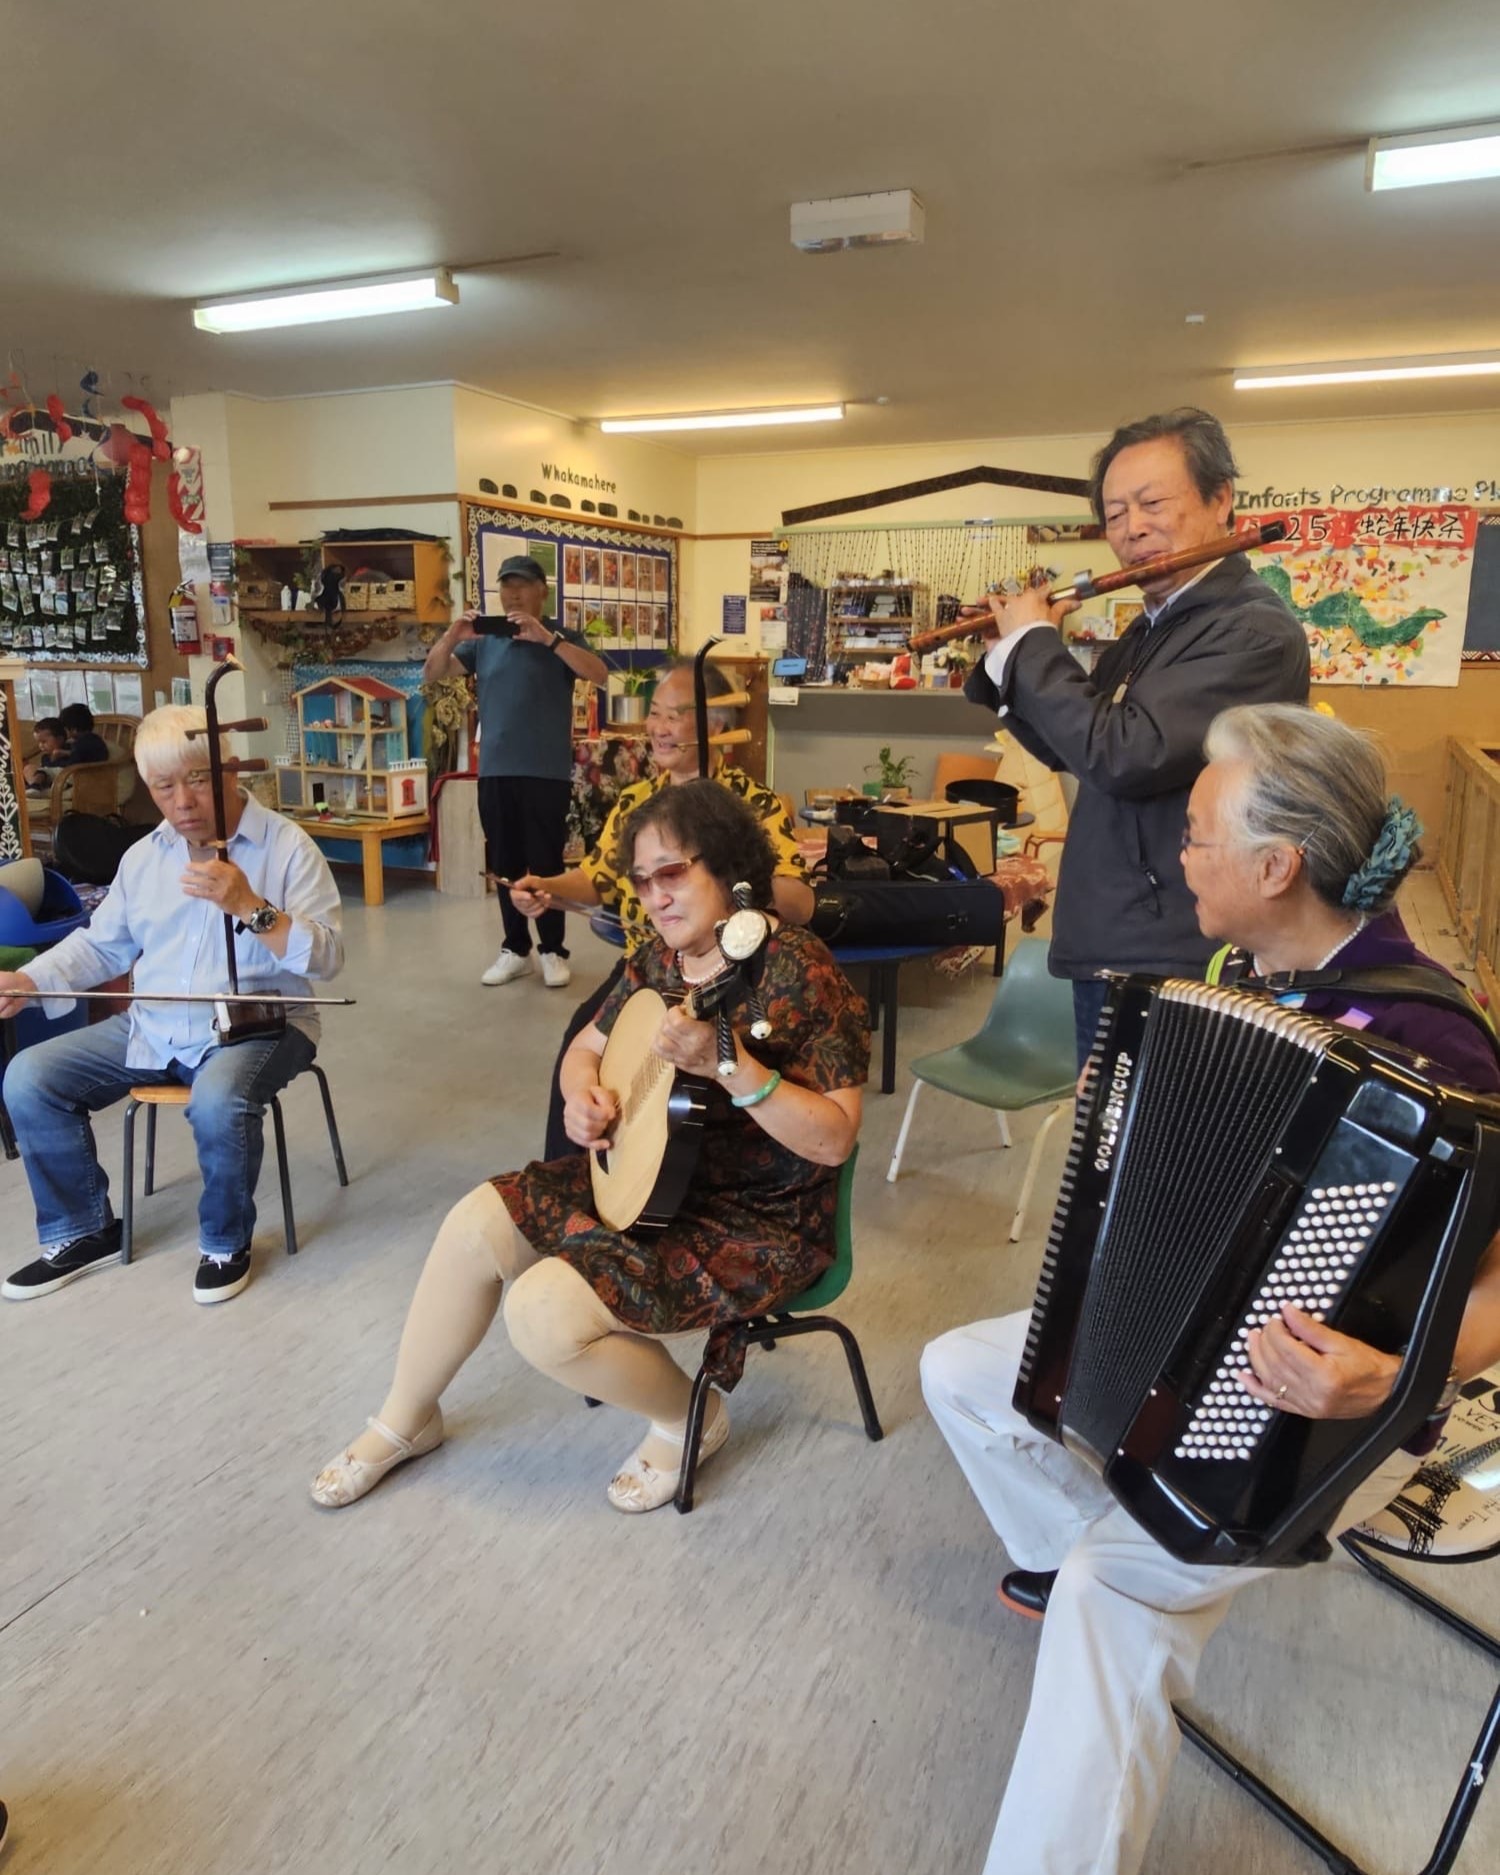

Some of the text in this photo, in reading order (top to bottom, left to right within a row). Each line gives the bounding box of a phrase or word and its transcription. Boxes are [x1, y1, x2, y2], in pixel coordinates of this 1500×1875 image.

[541, 462, 616, 493] Whakamahere
[1234, 486, 1321, 509] Infants
[1357, 512, 1463, 540] 蛇年快乐
